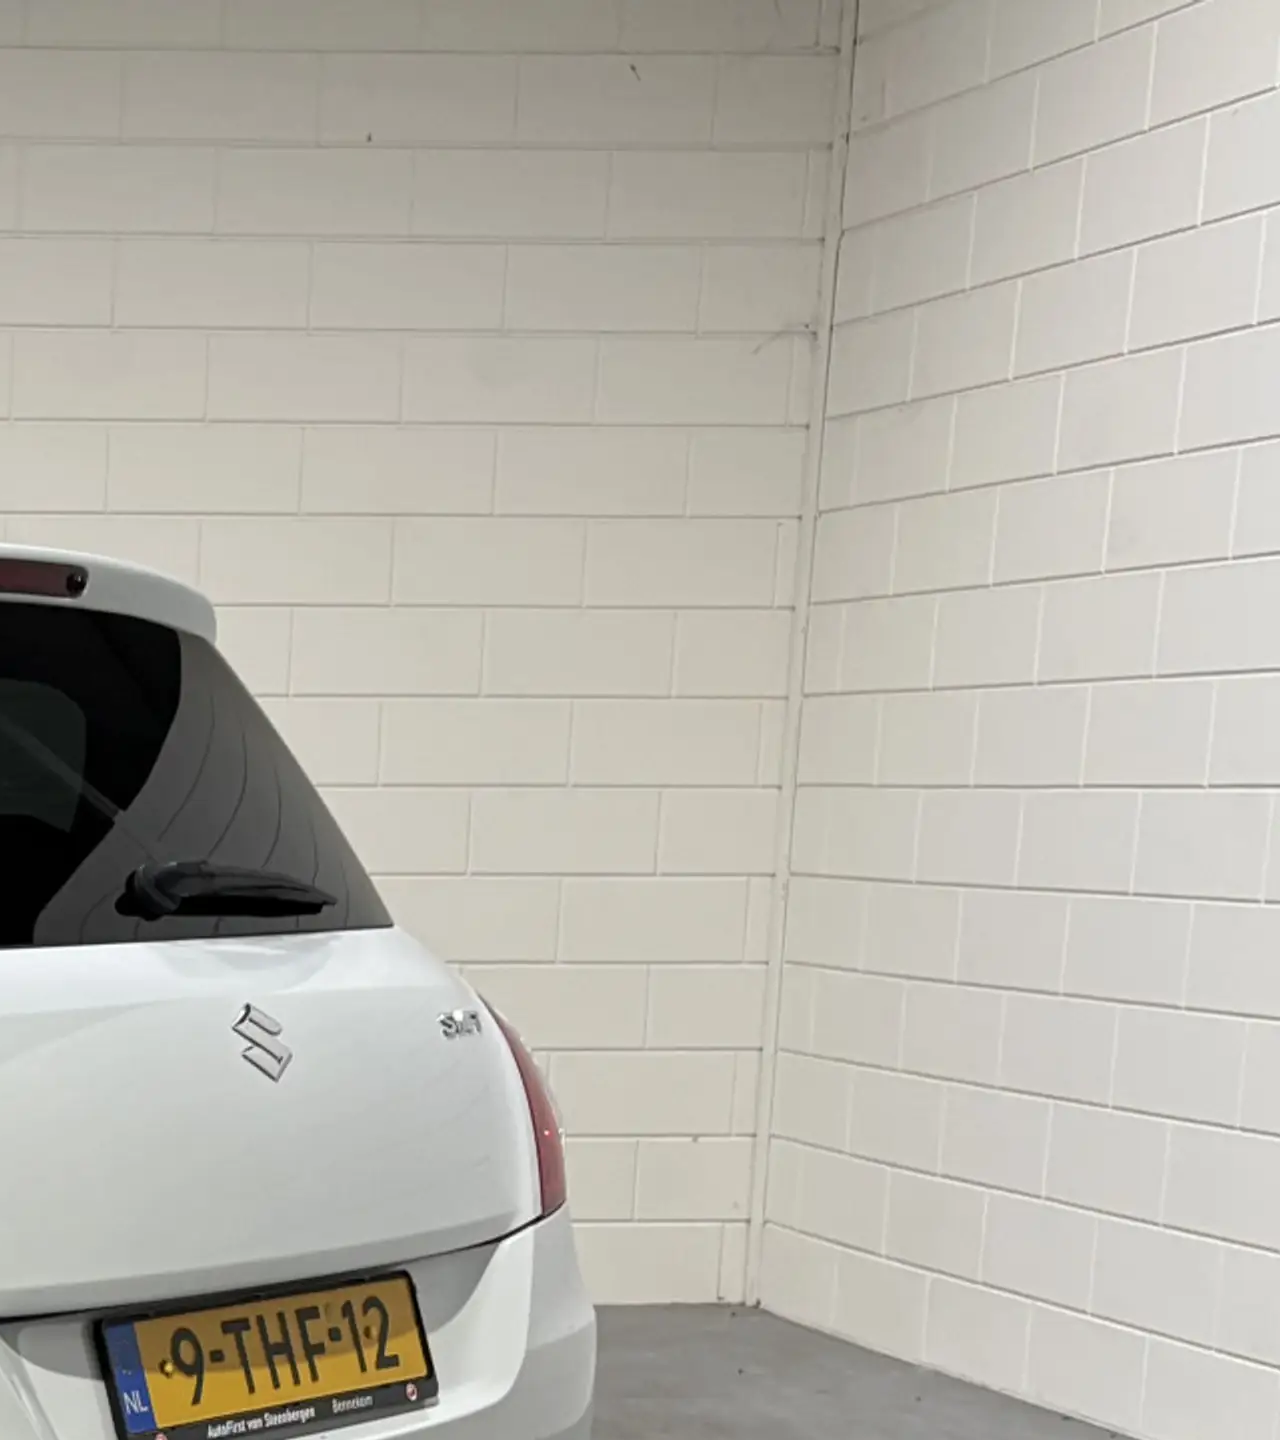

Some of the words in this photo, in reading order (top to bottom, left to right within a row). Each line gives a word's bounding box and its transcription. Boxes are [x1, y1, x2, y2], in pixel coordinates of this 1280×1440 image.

[170, 1296, 400, 1406] 9-THF-12
[122, 1390, 149, 1415] NL
[206, 1418, 246, 1439] AutoFirst
[247, 1416, 263, 1431] van
